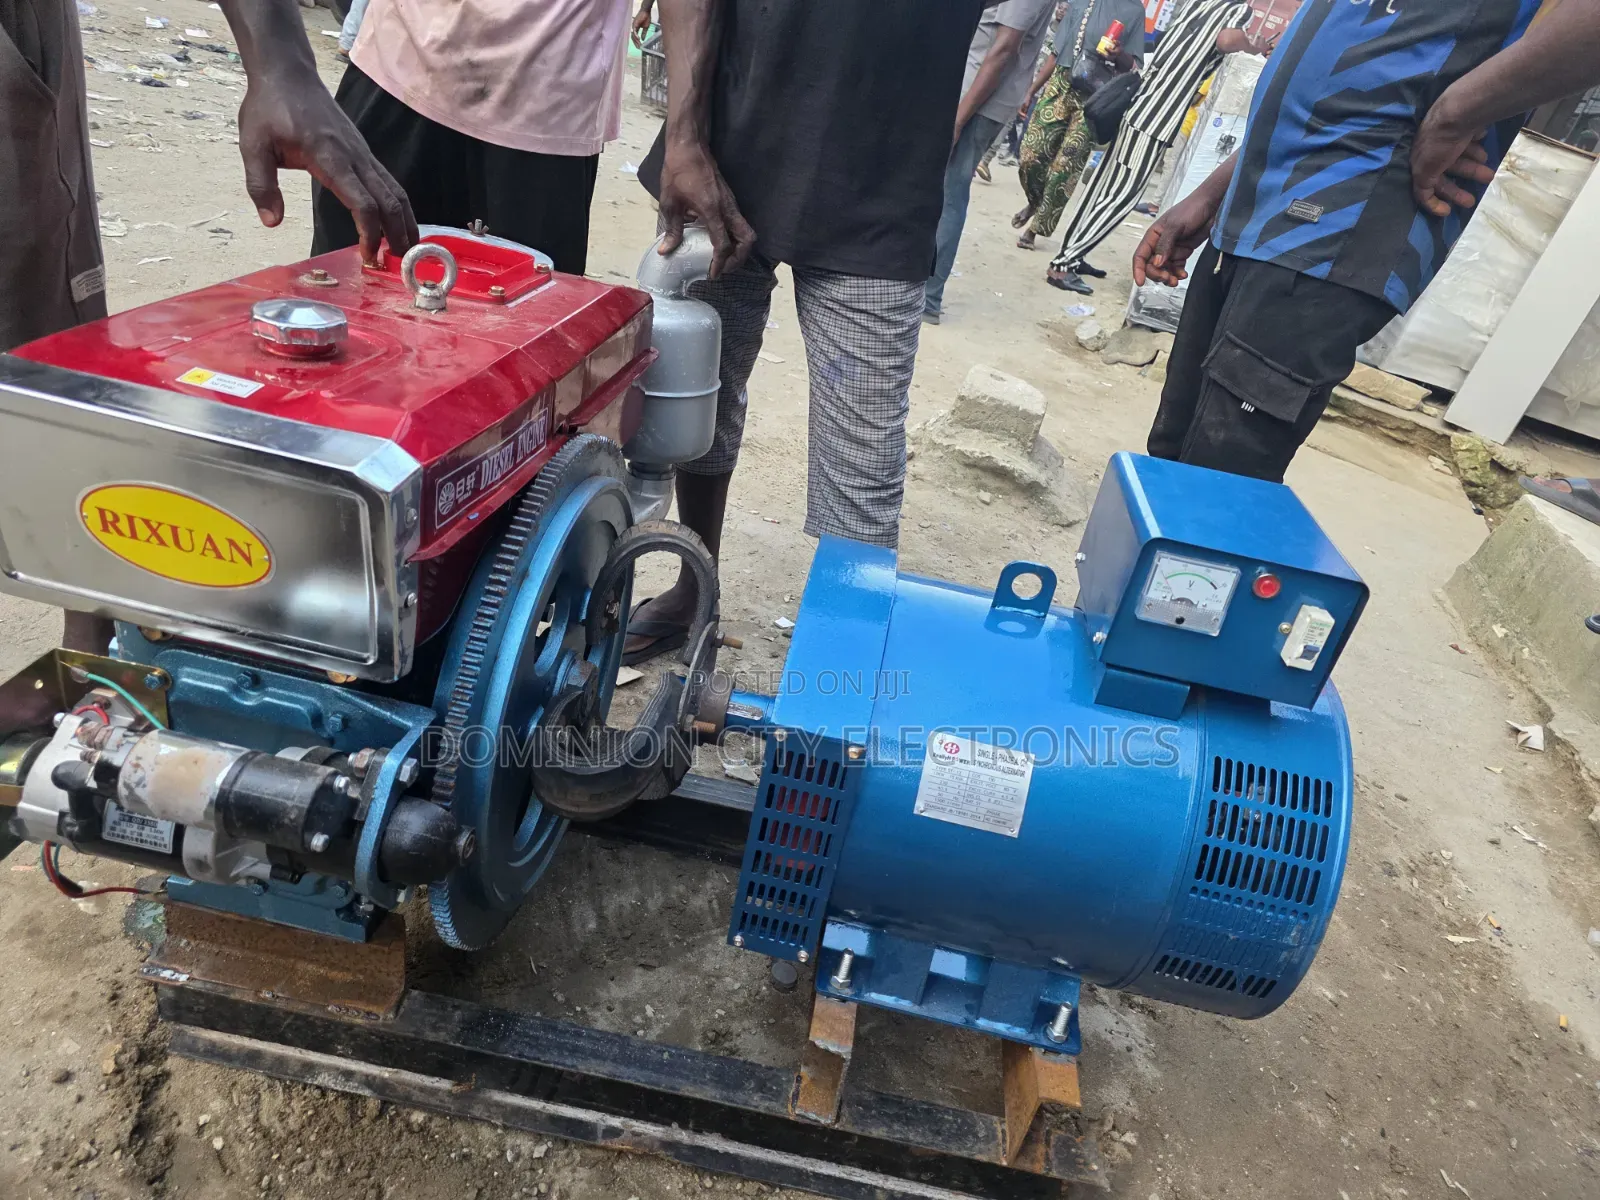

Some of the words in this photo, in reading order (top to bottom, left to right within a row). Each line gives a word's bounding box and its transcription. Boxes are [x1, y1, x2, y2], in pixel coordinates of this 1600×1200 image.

[480, 441, 515, 490] DIESEL
[516, 415, 546, 464] ENGINE
[95, 506, 253, 568] RIXUAN
[1000, 764, 1026, 777] ALTERNATOR
